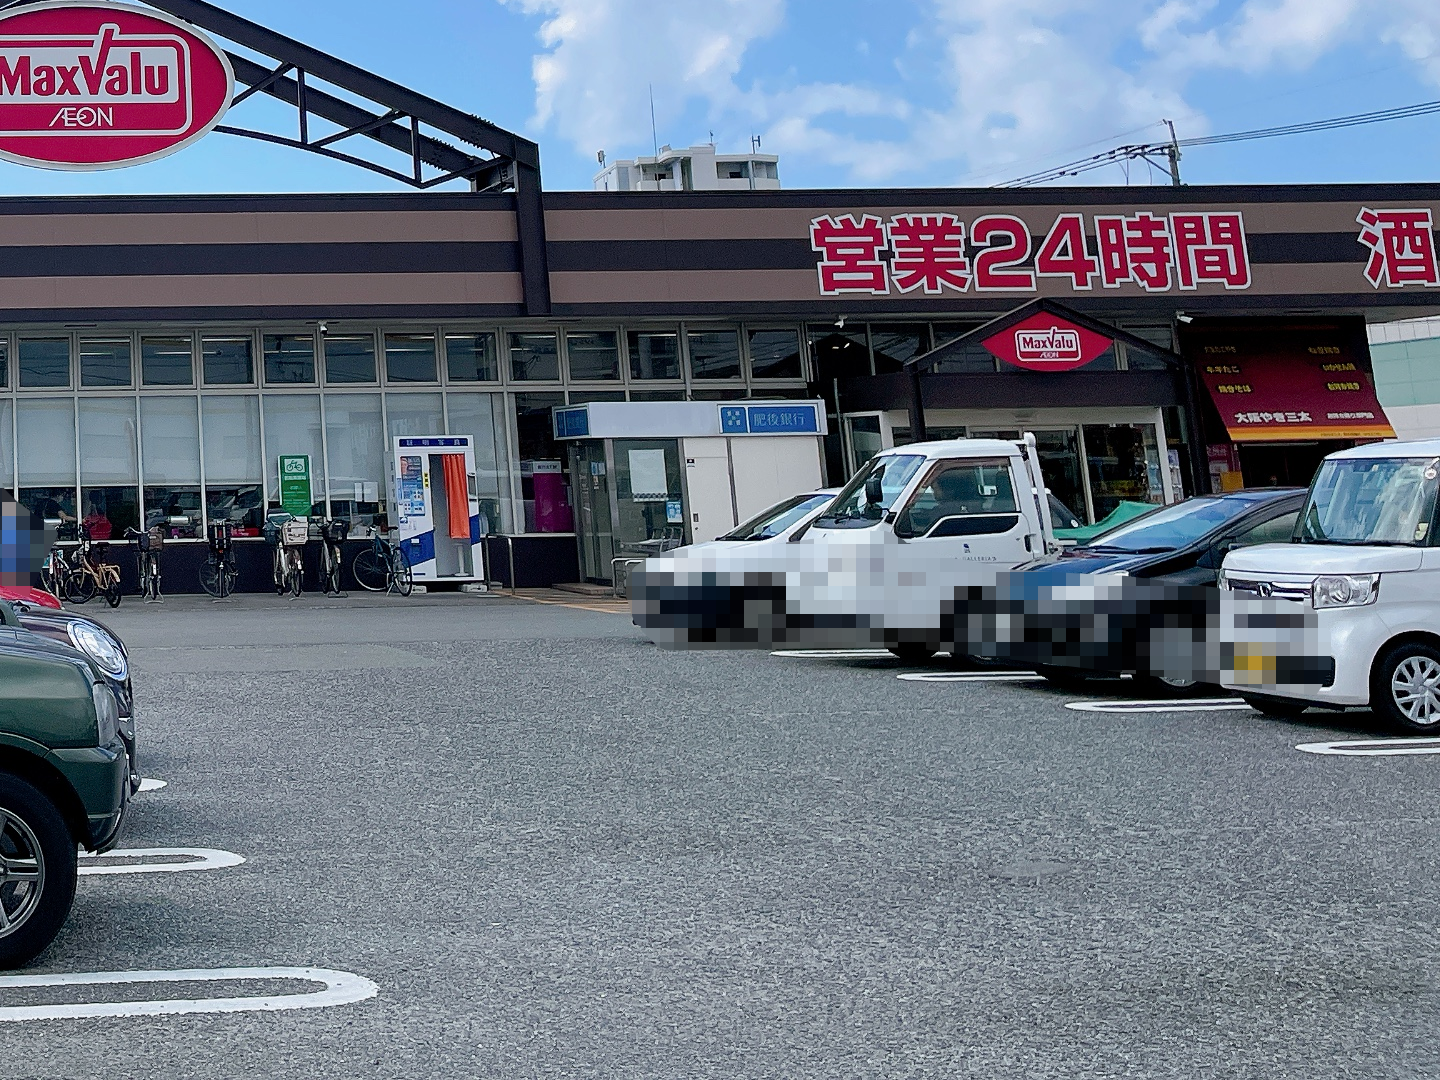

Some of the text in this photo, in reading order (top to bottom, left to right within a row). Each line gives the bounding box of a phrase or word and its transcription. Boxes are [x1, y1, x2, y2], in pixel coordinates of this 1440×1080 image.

[809, 210, 1252, 296] 営業24時間
[1355, 206, 1440, 290] 酒
[1022, 328, 1074, 349] MaxValu
[753, 412, 805, 427] 肥後銀行
[1234, 411, 1313, 424] 大阪やき三太
